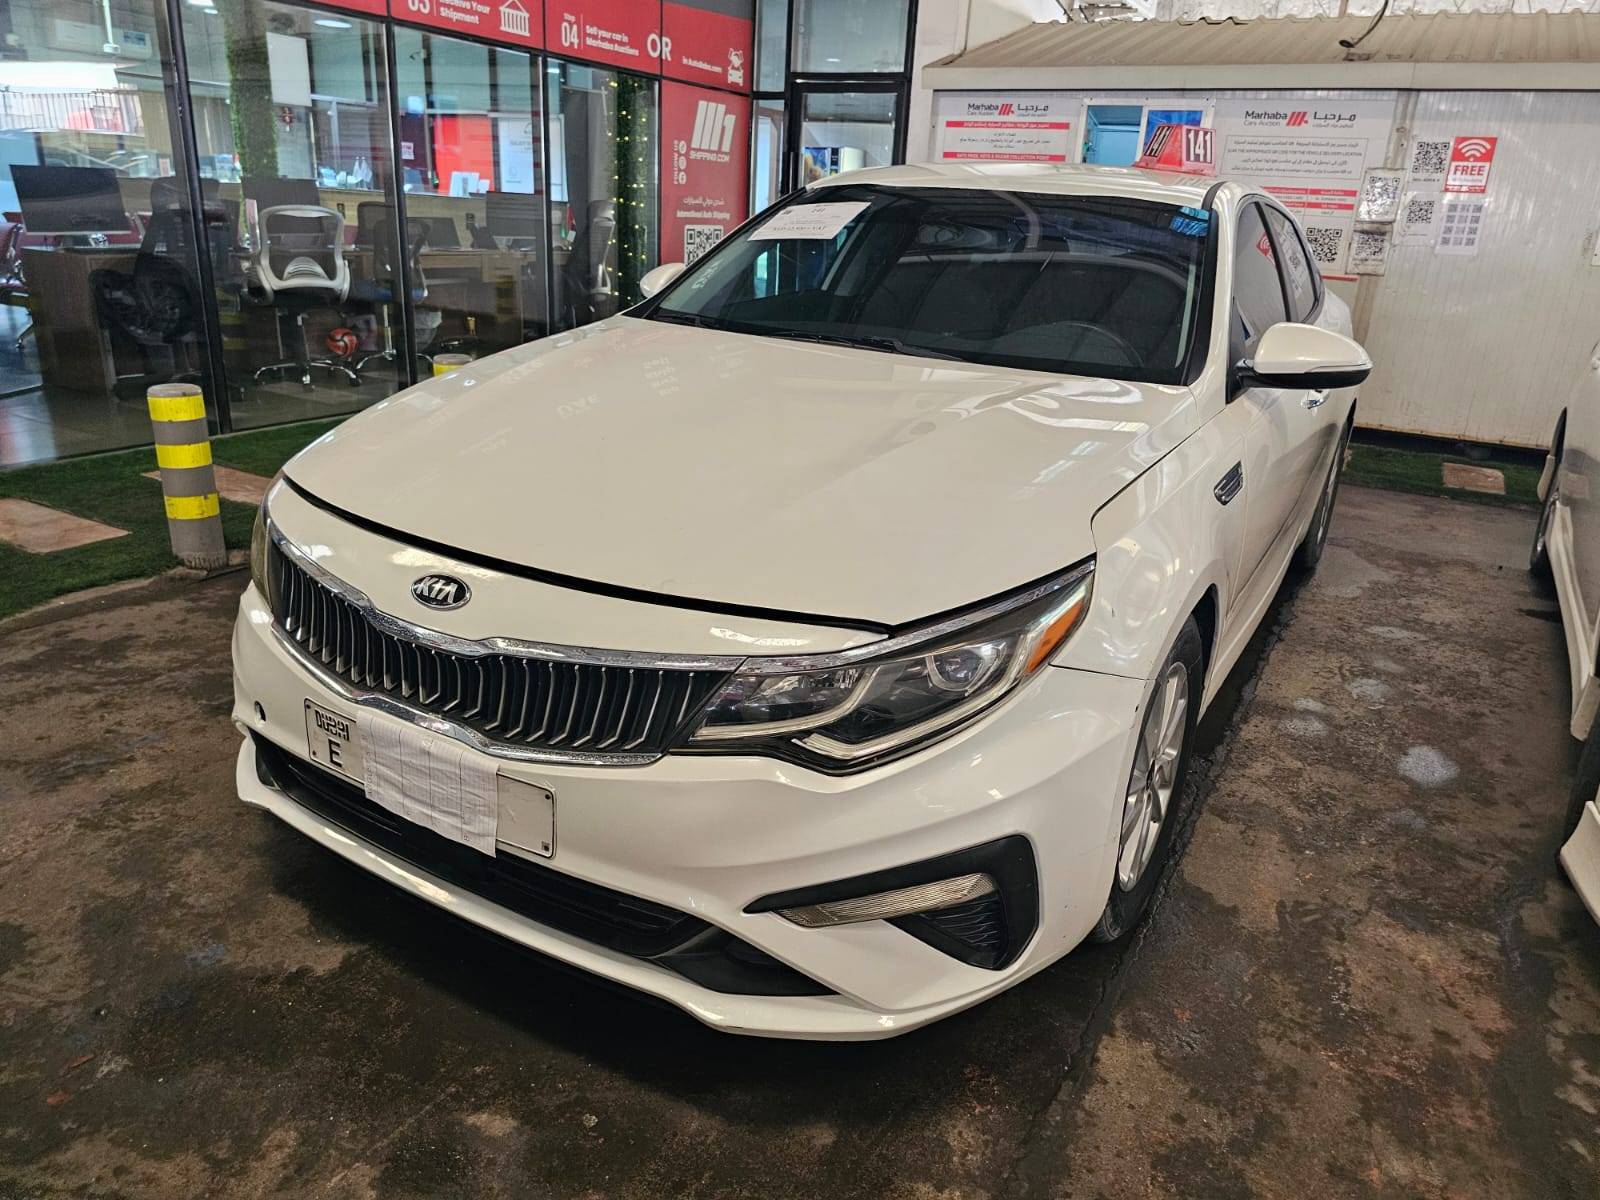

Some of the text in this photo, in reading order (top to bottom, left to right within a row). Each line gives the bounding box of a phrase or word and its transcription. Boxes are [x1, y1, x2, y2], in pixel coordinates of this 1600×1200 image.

[440, 7, 480, 25] Shipment
[561, 22, 579, 50] 04
[585, 25, 629, 43] Sell your car in
[647, 33, 672, 61] OR
[967, 102, 999, 112] Marhaba
[1017, 103, 1049, 113] مرحبا
[1244, 110, 1288, 120] Marhaba
[1313, 111, 1356, 123] مرحبا
[1188, 129, 1212, 163] 141
[689, 150, 731, 163] SHIPPING.COM
[1453, 165, 1486, 176] FREE
[413, 576, 458, 604] KIA
[328, 738, 343, 768] E
